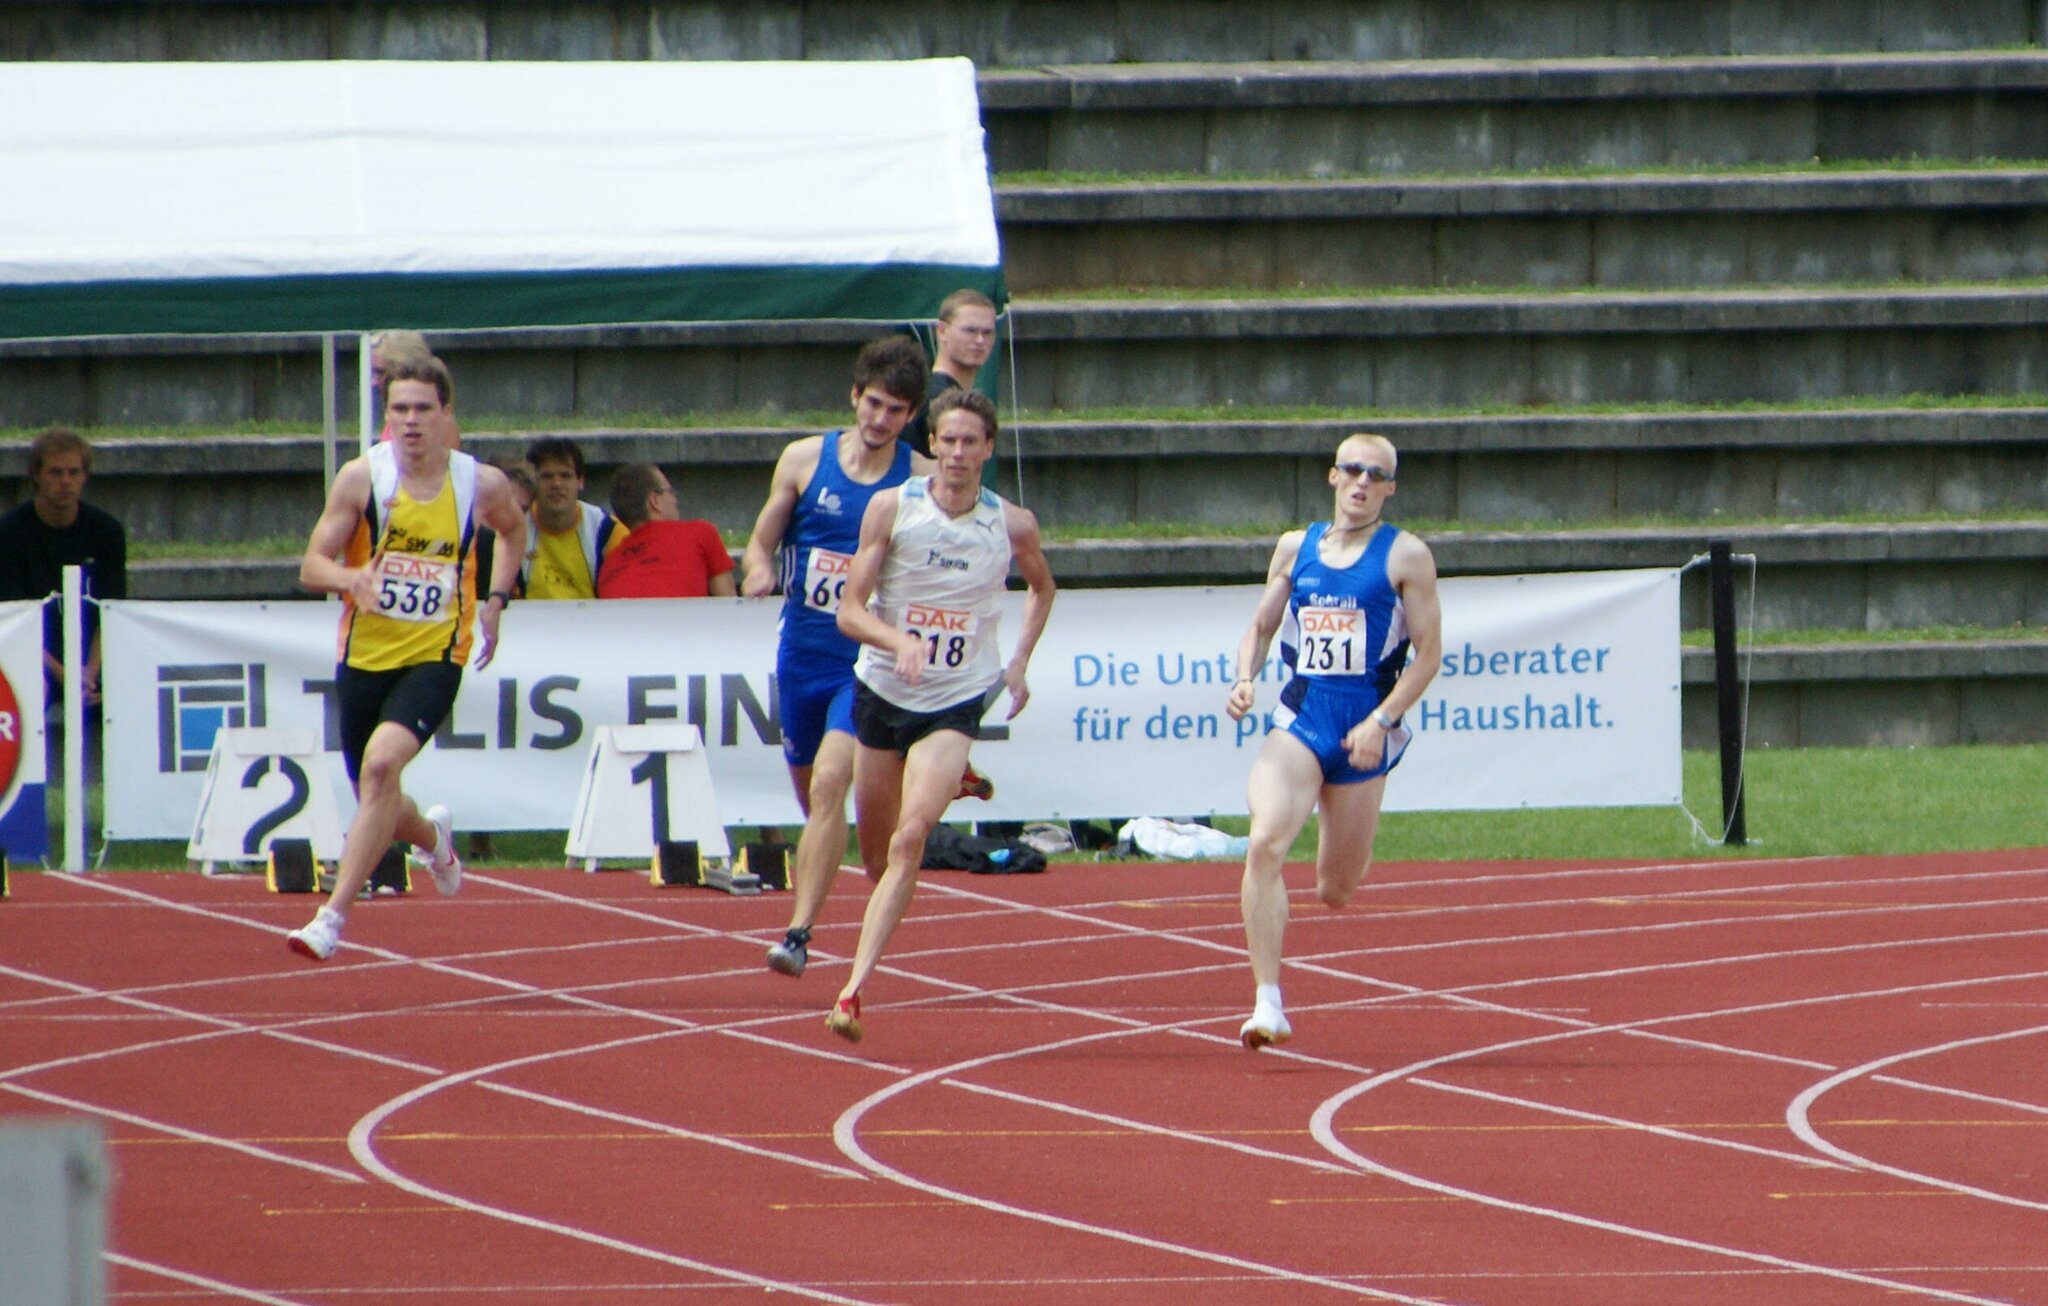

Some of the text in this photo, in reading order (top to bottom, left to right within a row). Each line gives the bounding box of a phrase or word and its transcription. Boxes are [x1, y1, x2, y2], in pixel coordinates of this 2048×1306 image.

[383, 557, 444, 580] DAK
[815, 551, 851, 574] DA
[379, 579, 442, 616] 538
[906, 604, 970, 641] DAK
[1303, 611, 1356, 633] DAK
[907, 628, 966, 668] 18
[1305, 637, 1352, 671] 231
[1074, 652, 1140, 687] Die
[1073, 706, 1131, 741] für
[1145, 704, 1218, 740] den
[1420, 693, 1614, 732] Haushalt.
[241, 755, 310, 854] 2
[632, 752, 669, 844] 1
